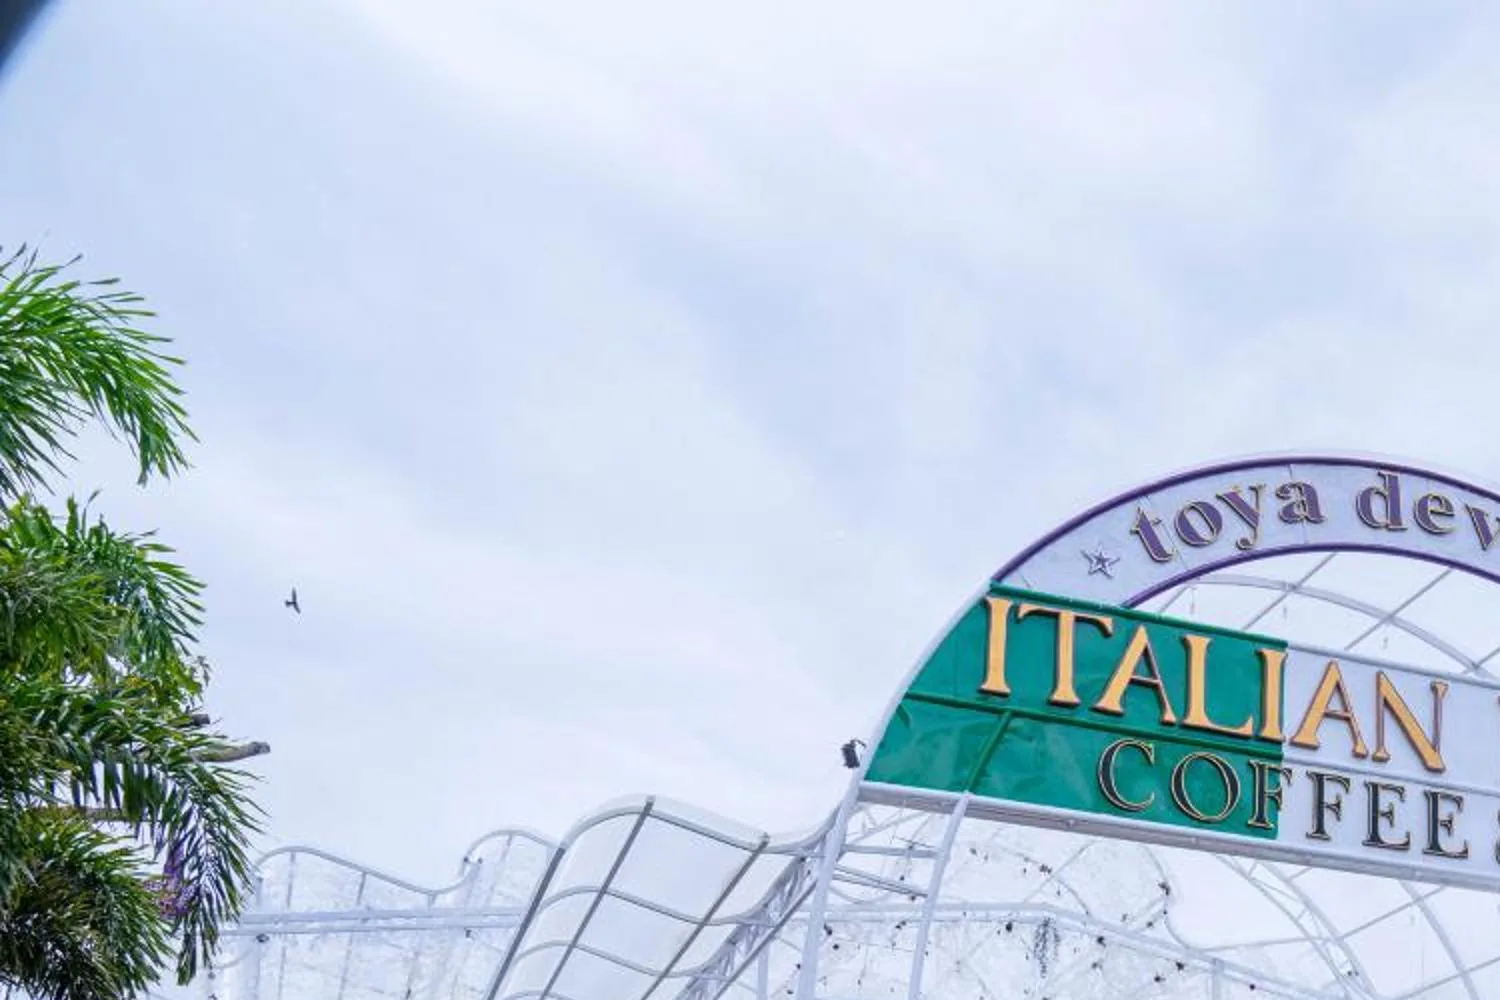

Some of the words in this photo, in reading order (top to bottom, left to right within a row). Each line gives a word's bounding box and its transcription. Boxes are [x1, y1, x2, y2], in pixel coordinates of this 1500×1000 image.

[1131, 478, 1325, 562] toya
[977, 597, 1449, 773] ITALIAN
[1098, 738, 1470, 860] COFFEE
